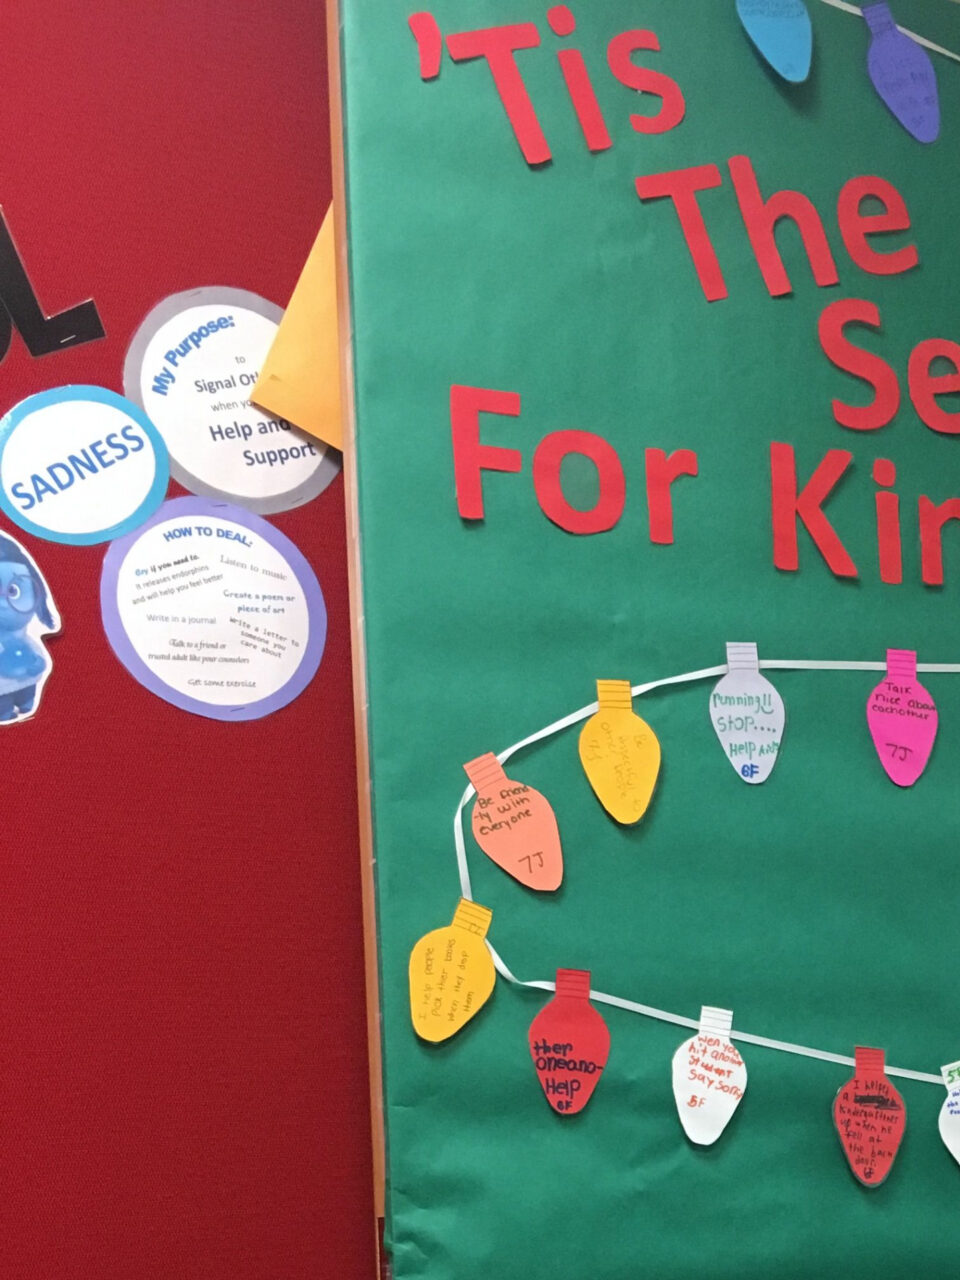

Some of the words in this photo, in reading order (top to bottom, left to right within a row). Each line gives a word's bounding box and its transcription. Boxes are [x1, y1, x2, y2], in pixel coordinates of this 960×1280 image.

[407, 5, 685, 166] 'Tis
[635, 154, 919, 302] The
[152, 366, 176, 396] My
[164, 315, 235, 367] Purpose:
[235, 355, 246, 364] to
[194, 375, 237, 394] Signal
[211, 400, 238, 412] when
[209, 422, 253, 441] Help
[243, 442, 317, 466] Support
[11, 425, 145, 510] SADNESS
[450, 383, 699, 545] For
[163, 527, 192, 542] HOW
[195, 527, 213, 537] TO
[217, 528, 253, 548] DEAL:
[158, 561, 172, 573] you
[220, 555, 248, 569] Listen
[250, 564, 259, 573] to
[262, 568, 287, 581] music
[142, 576, 171, 589] releases
[172, 565, 210, 581] endorphins
[132, 596, 146, 605] and
[147, 591, 158, 601] will
[160, 586, 175, 597] help
[176, 583, 189, 593] you
[189, 578, 202, 589] feel
[203, 573, 223, 584] better
[223, 589, 252, 600] Create
[262, 593, 284, 603] poem
[237, 605, 259, 614] piece
[262, 606, 272, 614] of
[146, 614, 169, 622] Write
[171, 614, 180, 622] in
[188, 615, 216, 625] journal
[240, 631, 270, 645] someone
[273, 641, 286, 651] you
[263, 628, 287, 642] letter
[292, 639, 300, 648] to
[241, 639, 257, 650] care
[261, 646, 282, 658] about
[226, 680, 256, 688] exercise
[876, 694, 900, 705] nice
[885, 743, 914, 762] 7J
[741, 763, 760, 778] 6F
[477, 796, 493, 810] Be
[497, 796, 531, 815] with
[479, 808, 532, 836] everyone
[518, 851, 545, 874] 7J
[688, 1042, 707, 1056] hit
[546, 1078, 581, 1099] Help
[853, 1079, 859, 1090] I
